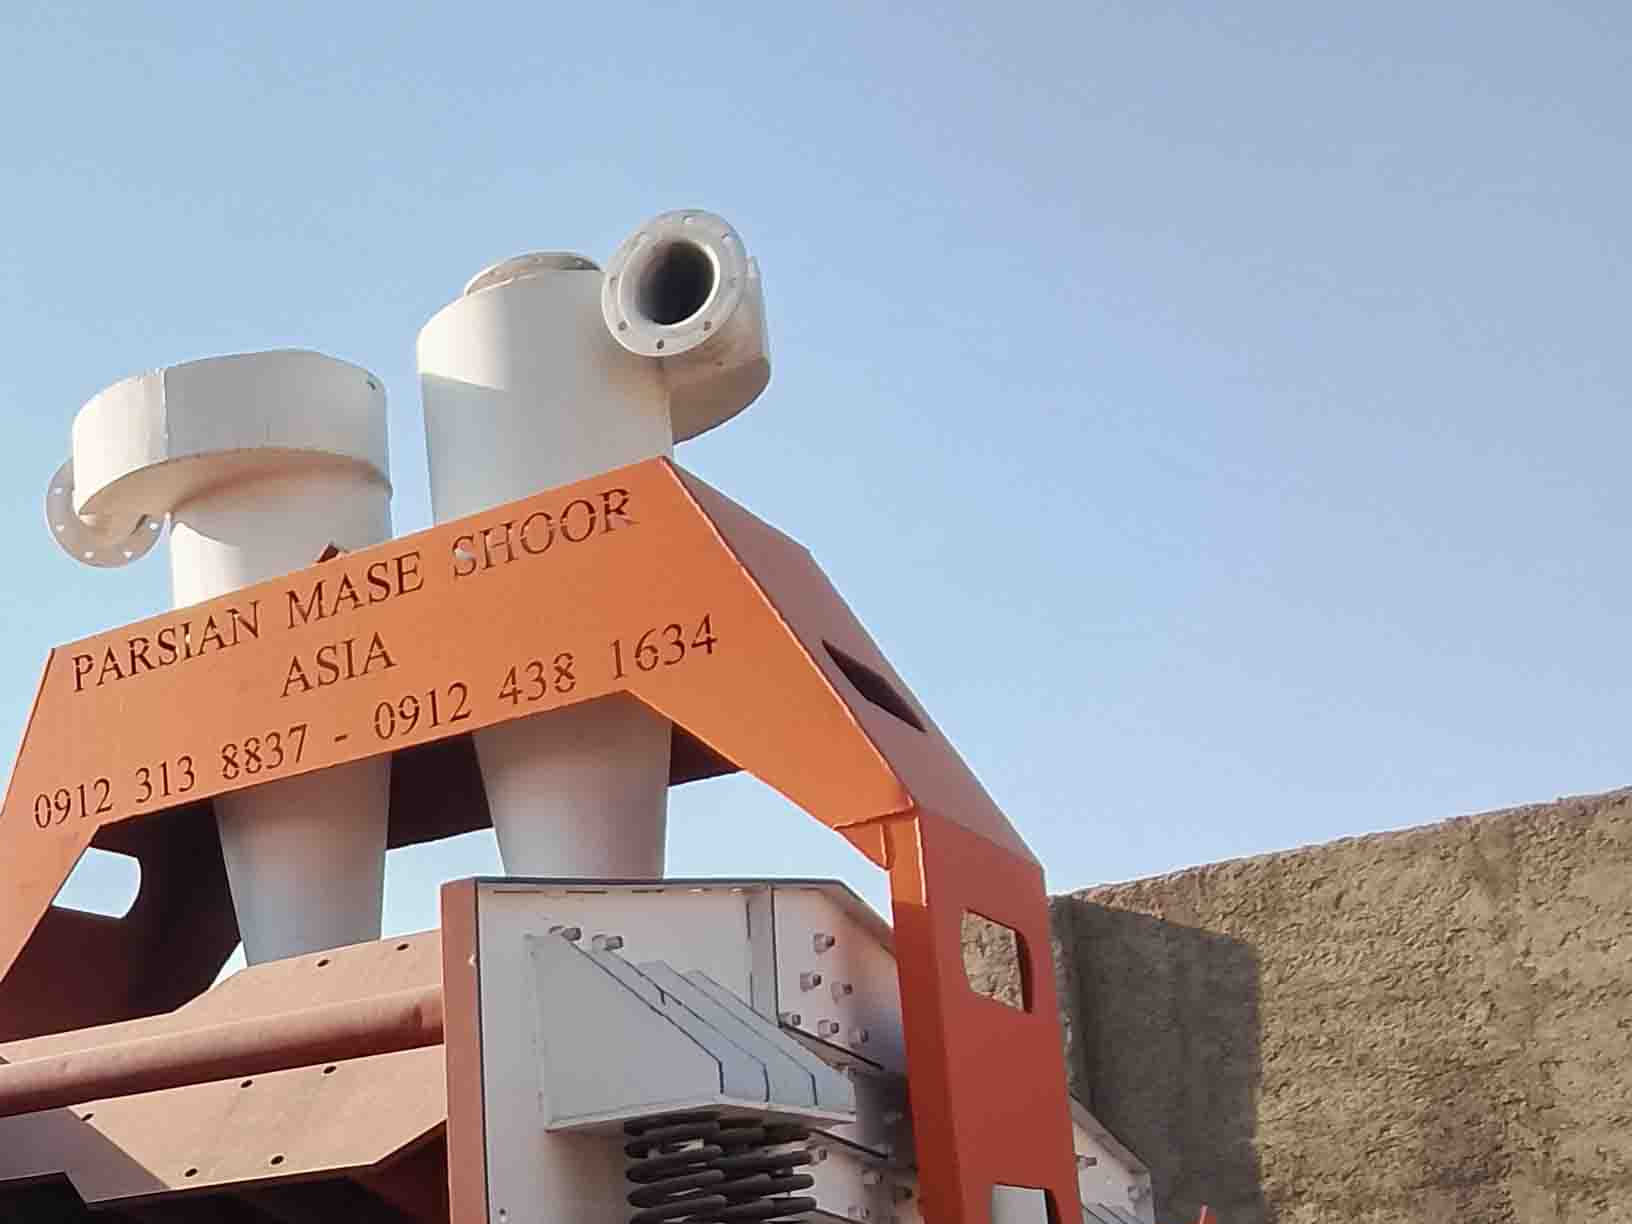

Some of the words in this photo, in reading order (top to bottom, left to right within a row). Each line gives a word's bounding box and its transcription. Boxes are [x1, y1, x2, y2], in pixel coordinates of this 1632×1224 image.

[72, 600, 261, 693] PARSIAN
[286, 551, 425, 630] MASE
[451, 488, 639, 578] SHOOR
[280, 632, 398, 699] ASIA
[34, 778, 114, 829] 0912
[135, 755, 197, 806] 313
[220, 724, 311, 782] 8837
[374, 681, 470, 741] 0912
[498, 652, 578, 706] 438
[609, 612, 718, 681] 1634
